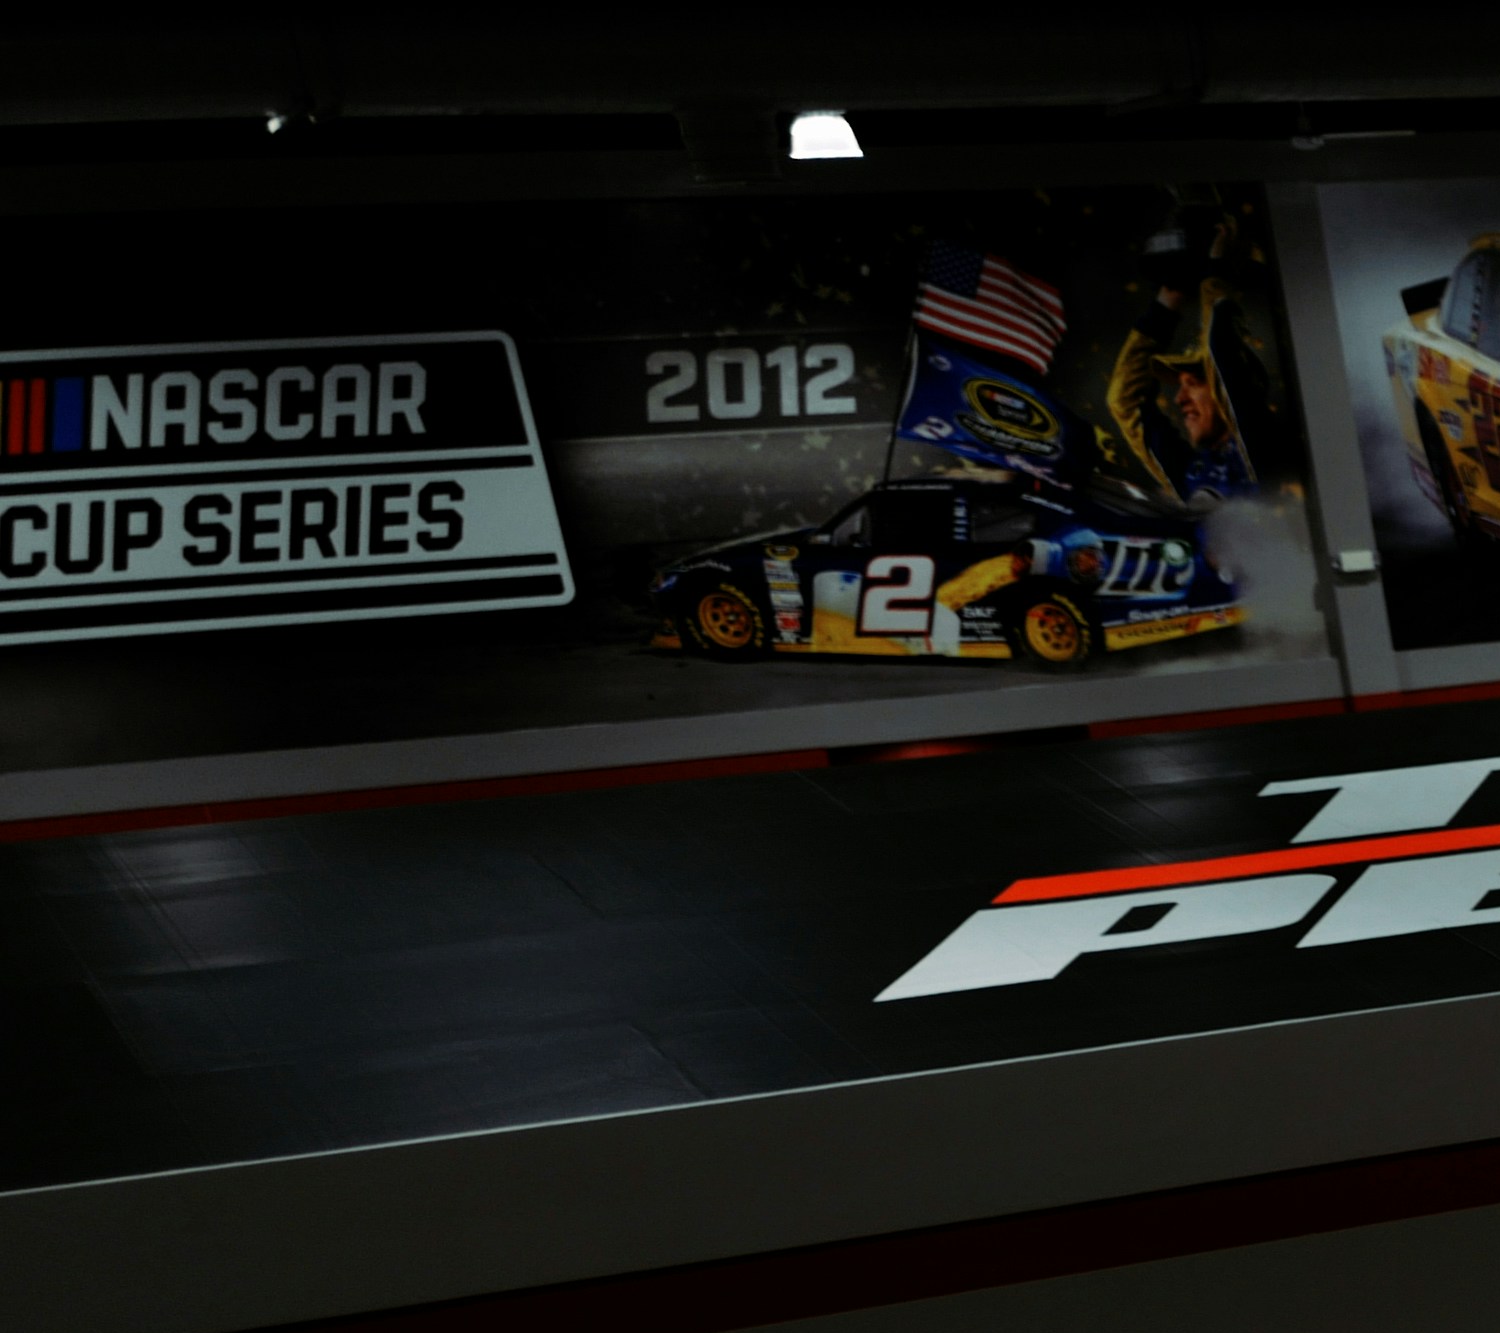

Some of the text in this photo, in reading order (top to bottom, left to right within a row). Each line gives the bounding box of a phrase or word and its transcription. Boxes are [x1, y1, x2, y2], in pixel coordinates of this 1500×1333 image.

[90, 361, 428, 451] NASCAR
[646, 343, 857, 423] 2012
[0, 481, 464, 577] CUP SERIES
[859, 554, 938, 635] 2
